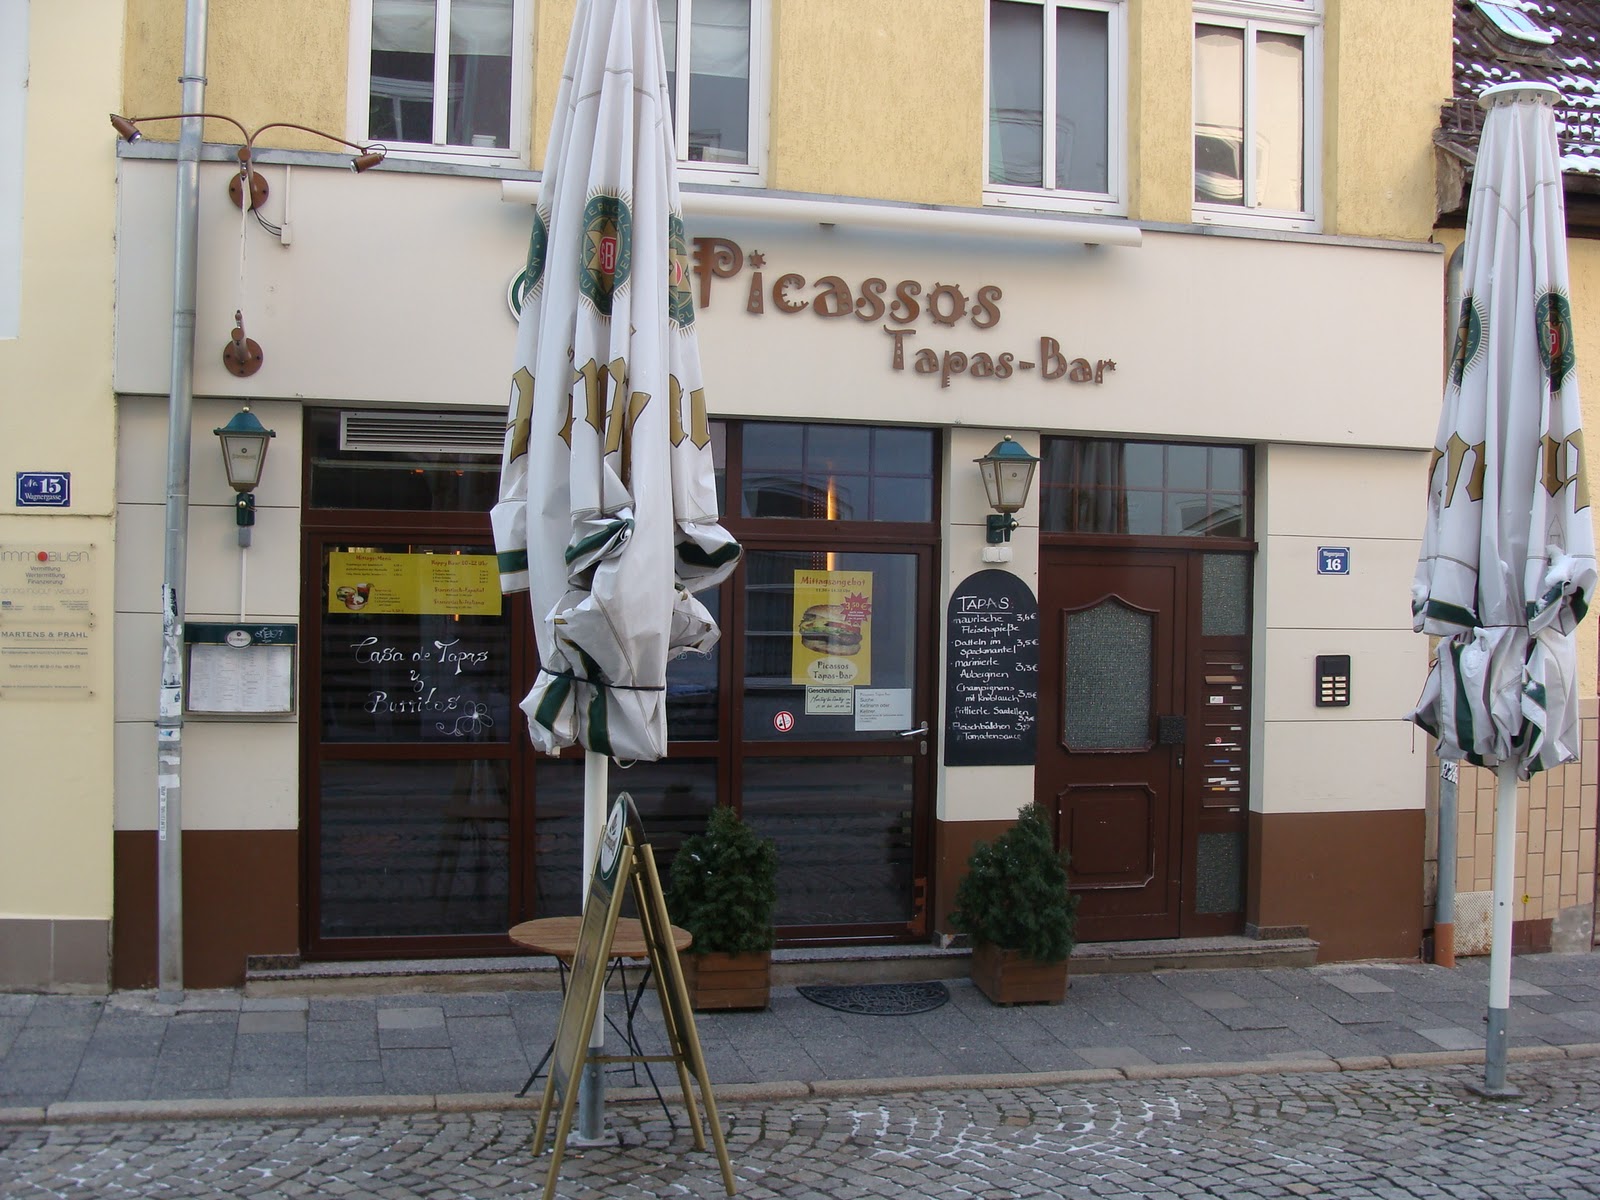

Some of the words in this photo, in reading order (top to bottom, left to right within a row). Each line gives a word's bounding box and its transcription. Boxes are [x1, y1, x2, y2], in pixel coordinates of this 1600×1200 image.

[693, 237, 1003, 329] Picassos
[883, 325, 1117, 388] Tapas-Bar
[40, 478, 62, 494] 15
[24, 493, 62, 502] Wagnergasse
[1325, 558, 1341, 571] 16
[800, 575, 866, 588] Mittagsangebot
[350, 636, 404, 664] Casa
[412, 646, 431, 661] de
[434, 638, 489, 675] Tapas
[817, 660, 849, 670] Picassos
[813, 671, 853, 681] Tapas-Bar
[364, 687, 461, 714] Burritos
